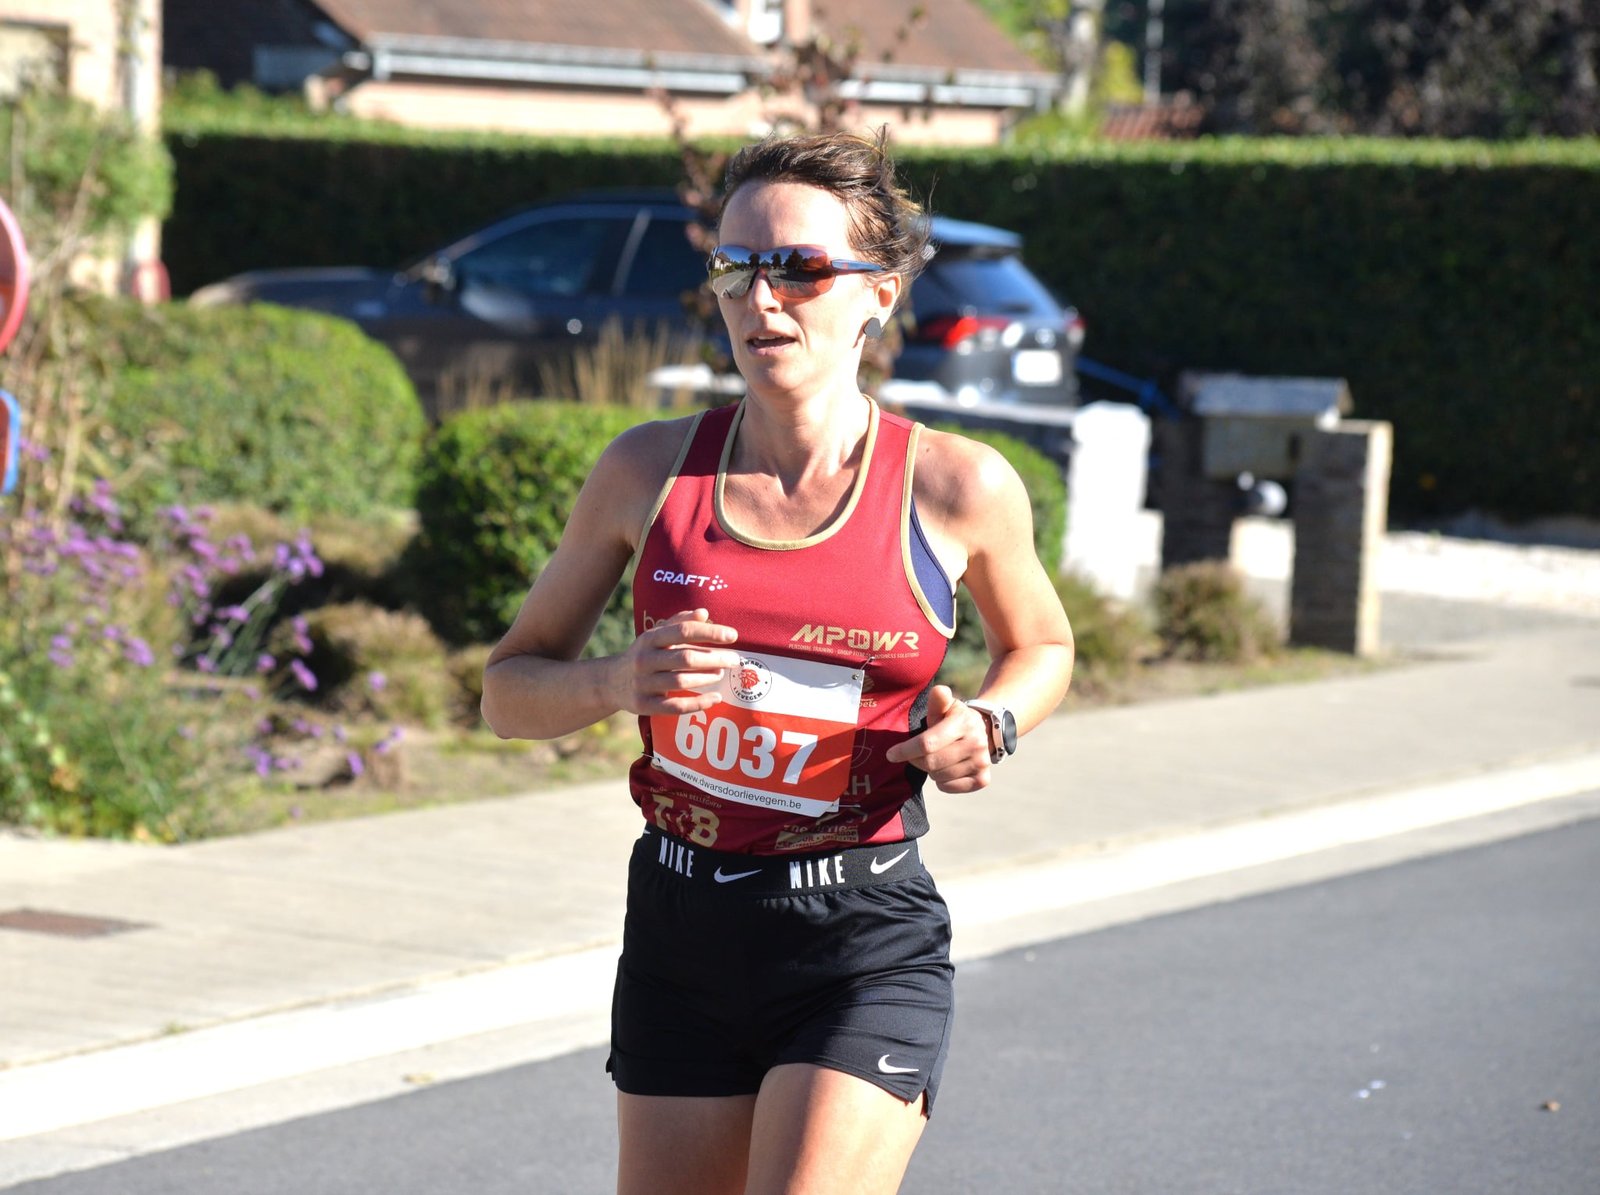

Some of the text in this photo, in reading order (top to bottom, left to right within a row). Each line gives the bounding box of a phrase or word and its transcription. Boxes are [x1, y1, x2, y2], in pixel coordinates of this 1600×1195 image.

[653, 569, 710, 587] CRAFT
[790, 623, 919, 651] MPOWR
[675, 710, 818, 785] 6037
[680, 768, 802, 810] www.dwarsdoorlievegem.be
[659, 836, 694, 878] NIKE
[789, 855, 845, 889] NIKE
